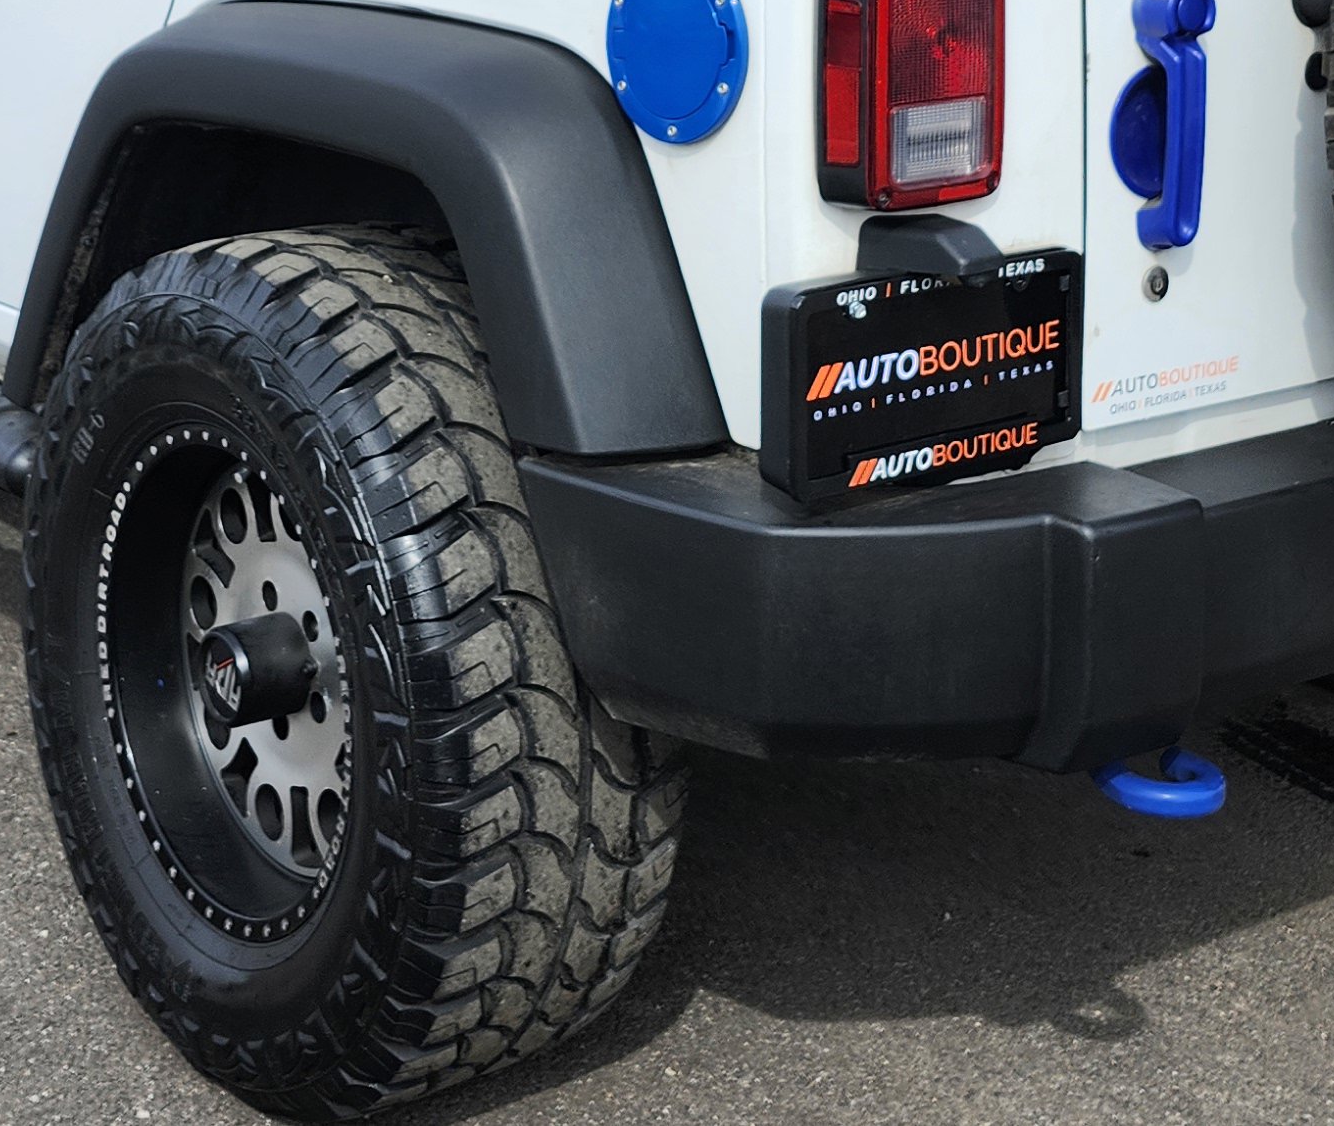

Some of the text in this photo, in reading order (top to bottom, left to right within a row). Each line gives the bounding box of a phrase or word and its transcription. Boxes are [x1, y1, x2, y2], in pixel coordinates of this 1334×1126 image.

[836, 286, 877, 306] OHIO
[899, 277, 951, 295] FLOR
[813, 360, 1054, 421] OHIO FLORIDA TEXAS
[1109, 380, 1227, 415] OHIO FLORIDA TEXAS
[97, 492, 127, 701] RED DIRT ROAD
